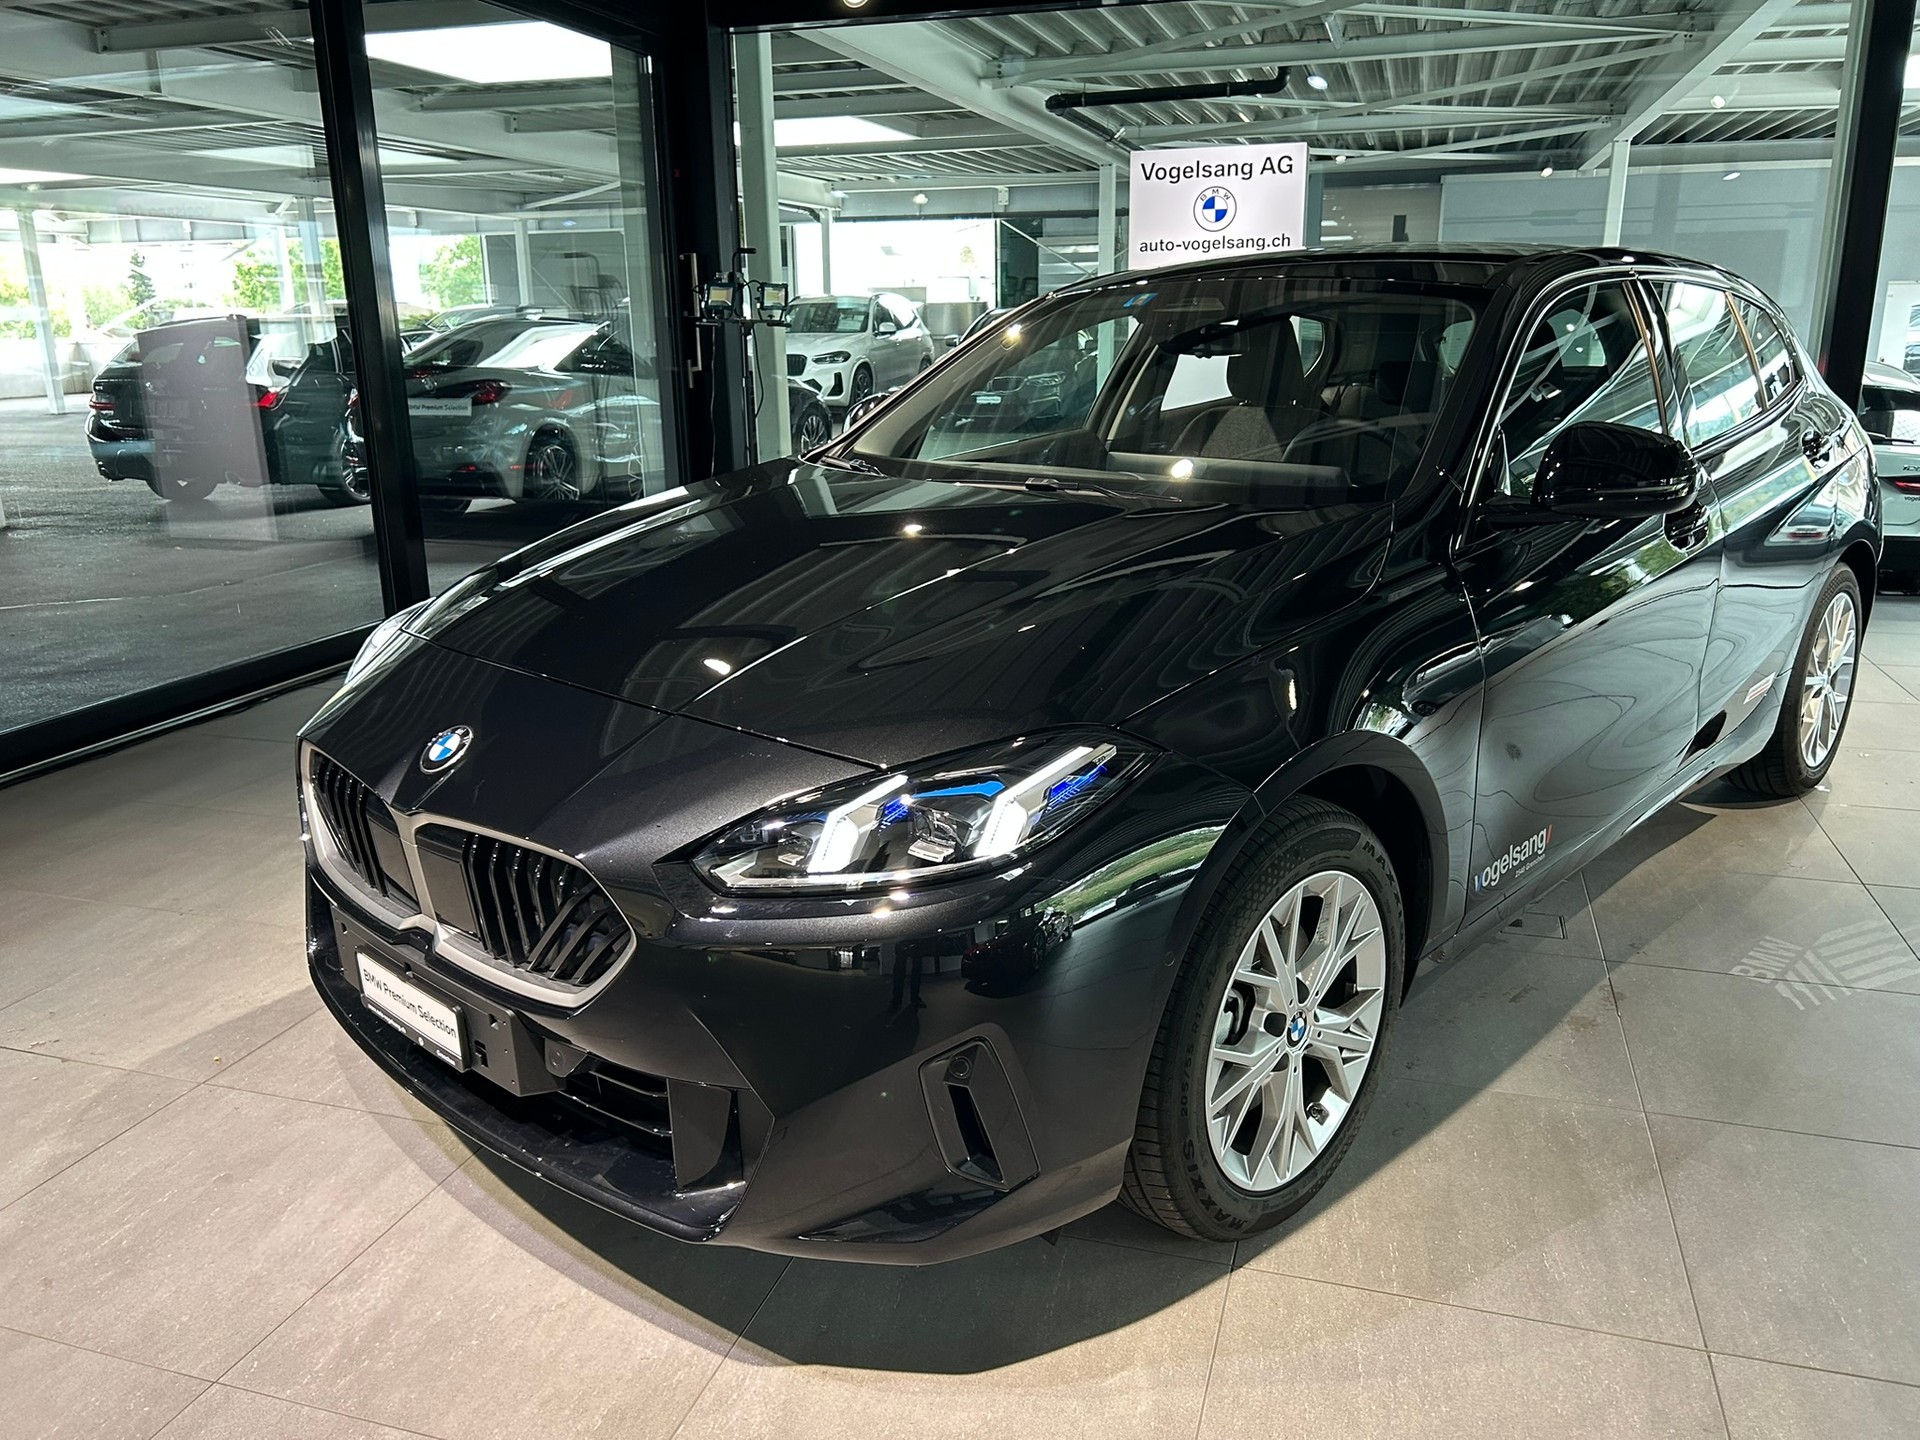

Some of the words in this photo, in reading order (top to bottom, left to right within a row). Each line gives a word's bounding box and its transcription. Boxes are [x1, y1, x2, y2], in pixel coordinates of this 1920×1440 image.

[1141, 160, 1253, 184] Vogelsang
[1260, 155, 1293, 175] AG
[1199, 188, 1231, 201] BMW
[1139, 233, 1291, 253] auto-vogelsang.ch
[363, 969, 382, 991] BMW
[383, 983, 417, 1013] Premium
[417, 1005, 457, 1038] Selection
